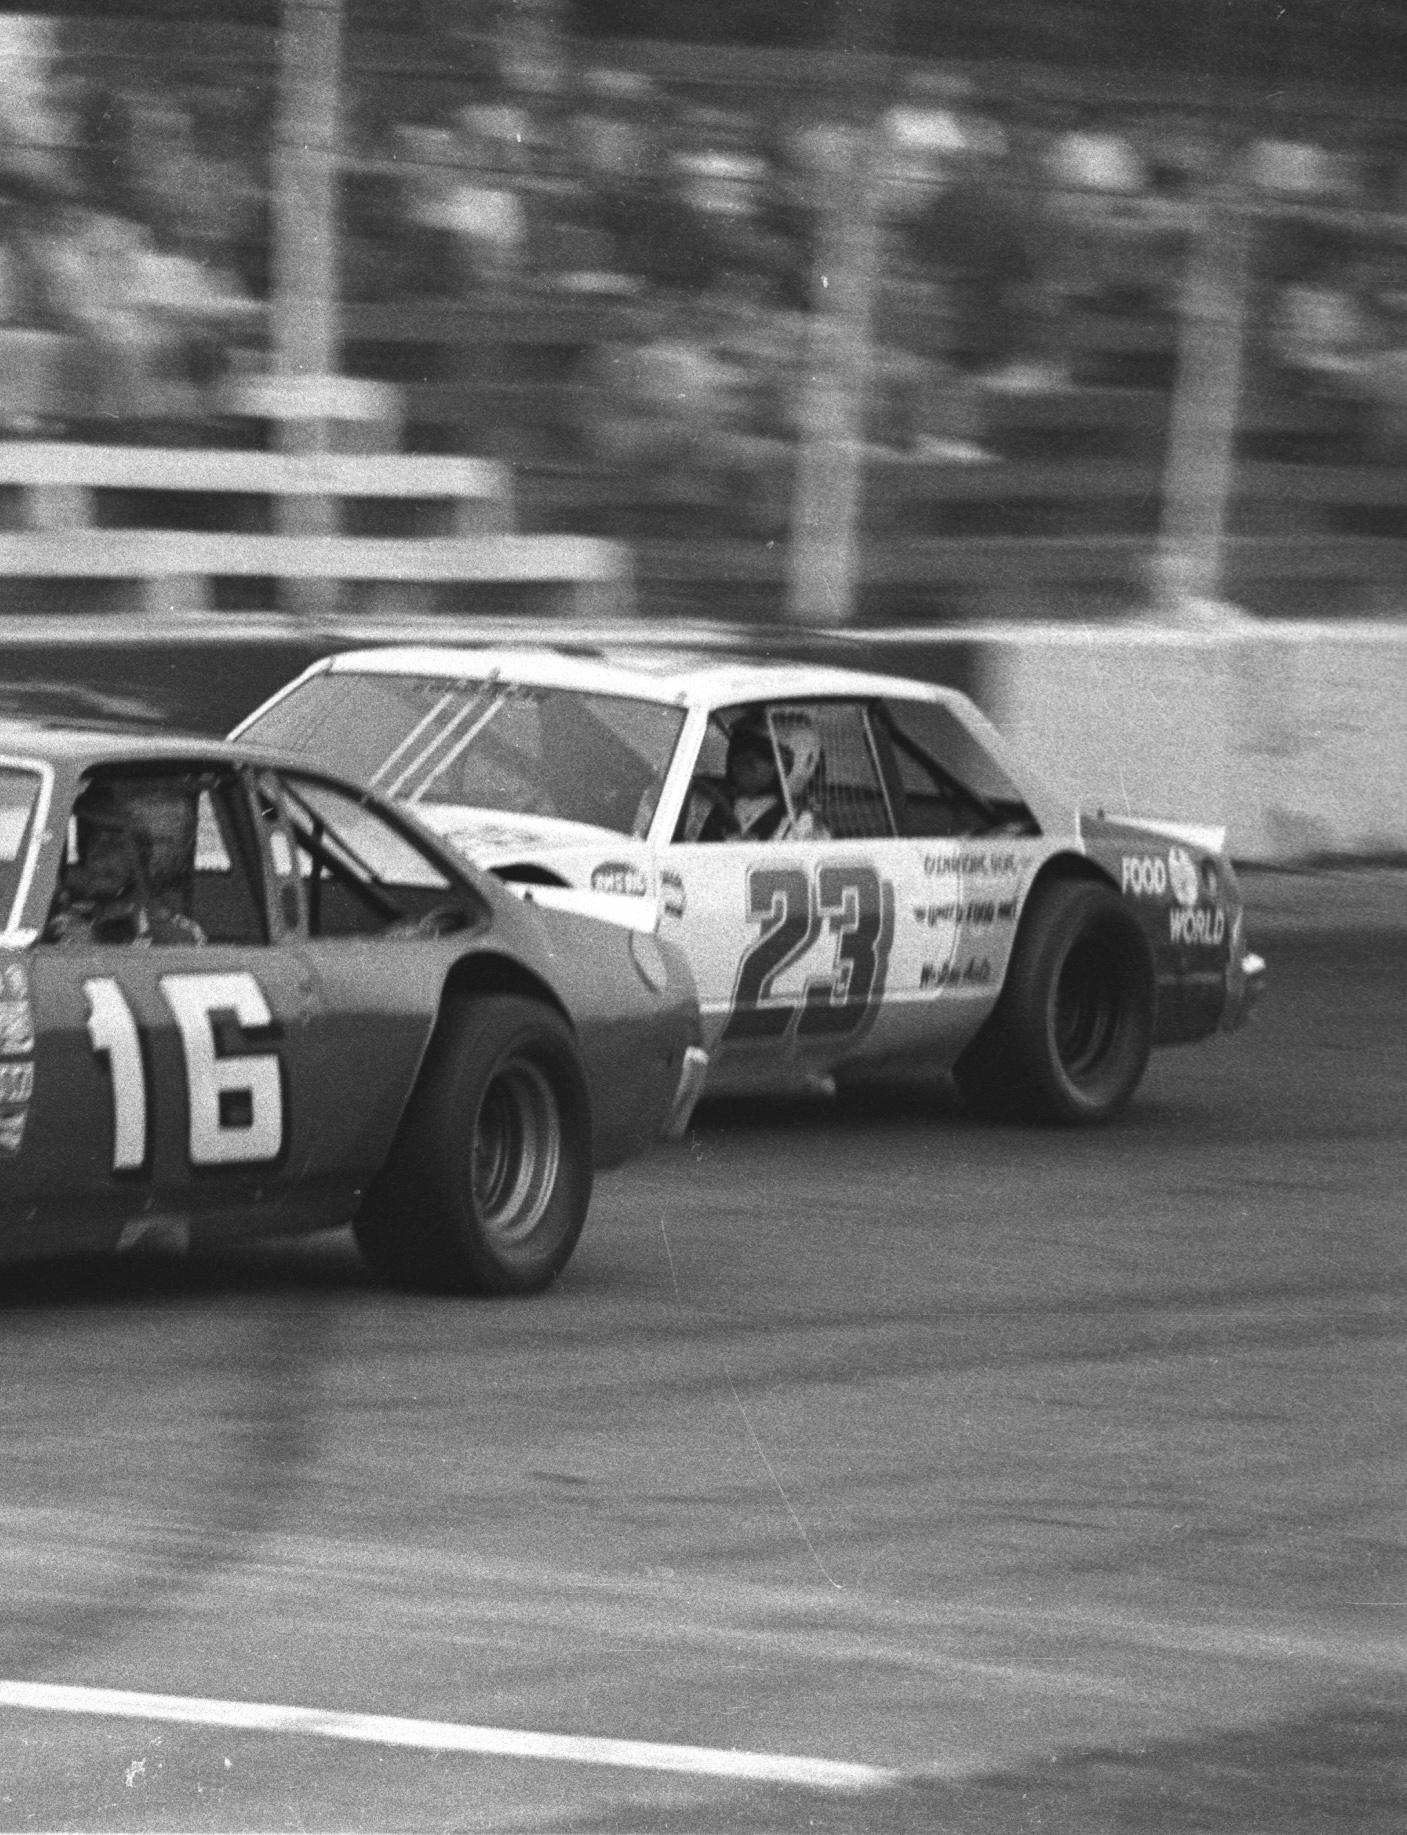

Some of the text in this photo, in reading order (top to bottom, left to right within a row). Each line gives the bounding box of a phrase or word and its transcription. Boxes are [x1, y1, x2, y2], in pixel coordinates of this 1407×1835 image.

[1121, 855, 1167, 897] FOOD
[1169, 907, 1225, 945] WORLD
[714, 860, 894, 1044] 23
[83, 971, 284, 1171] 16
